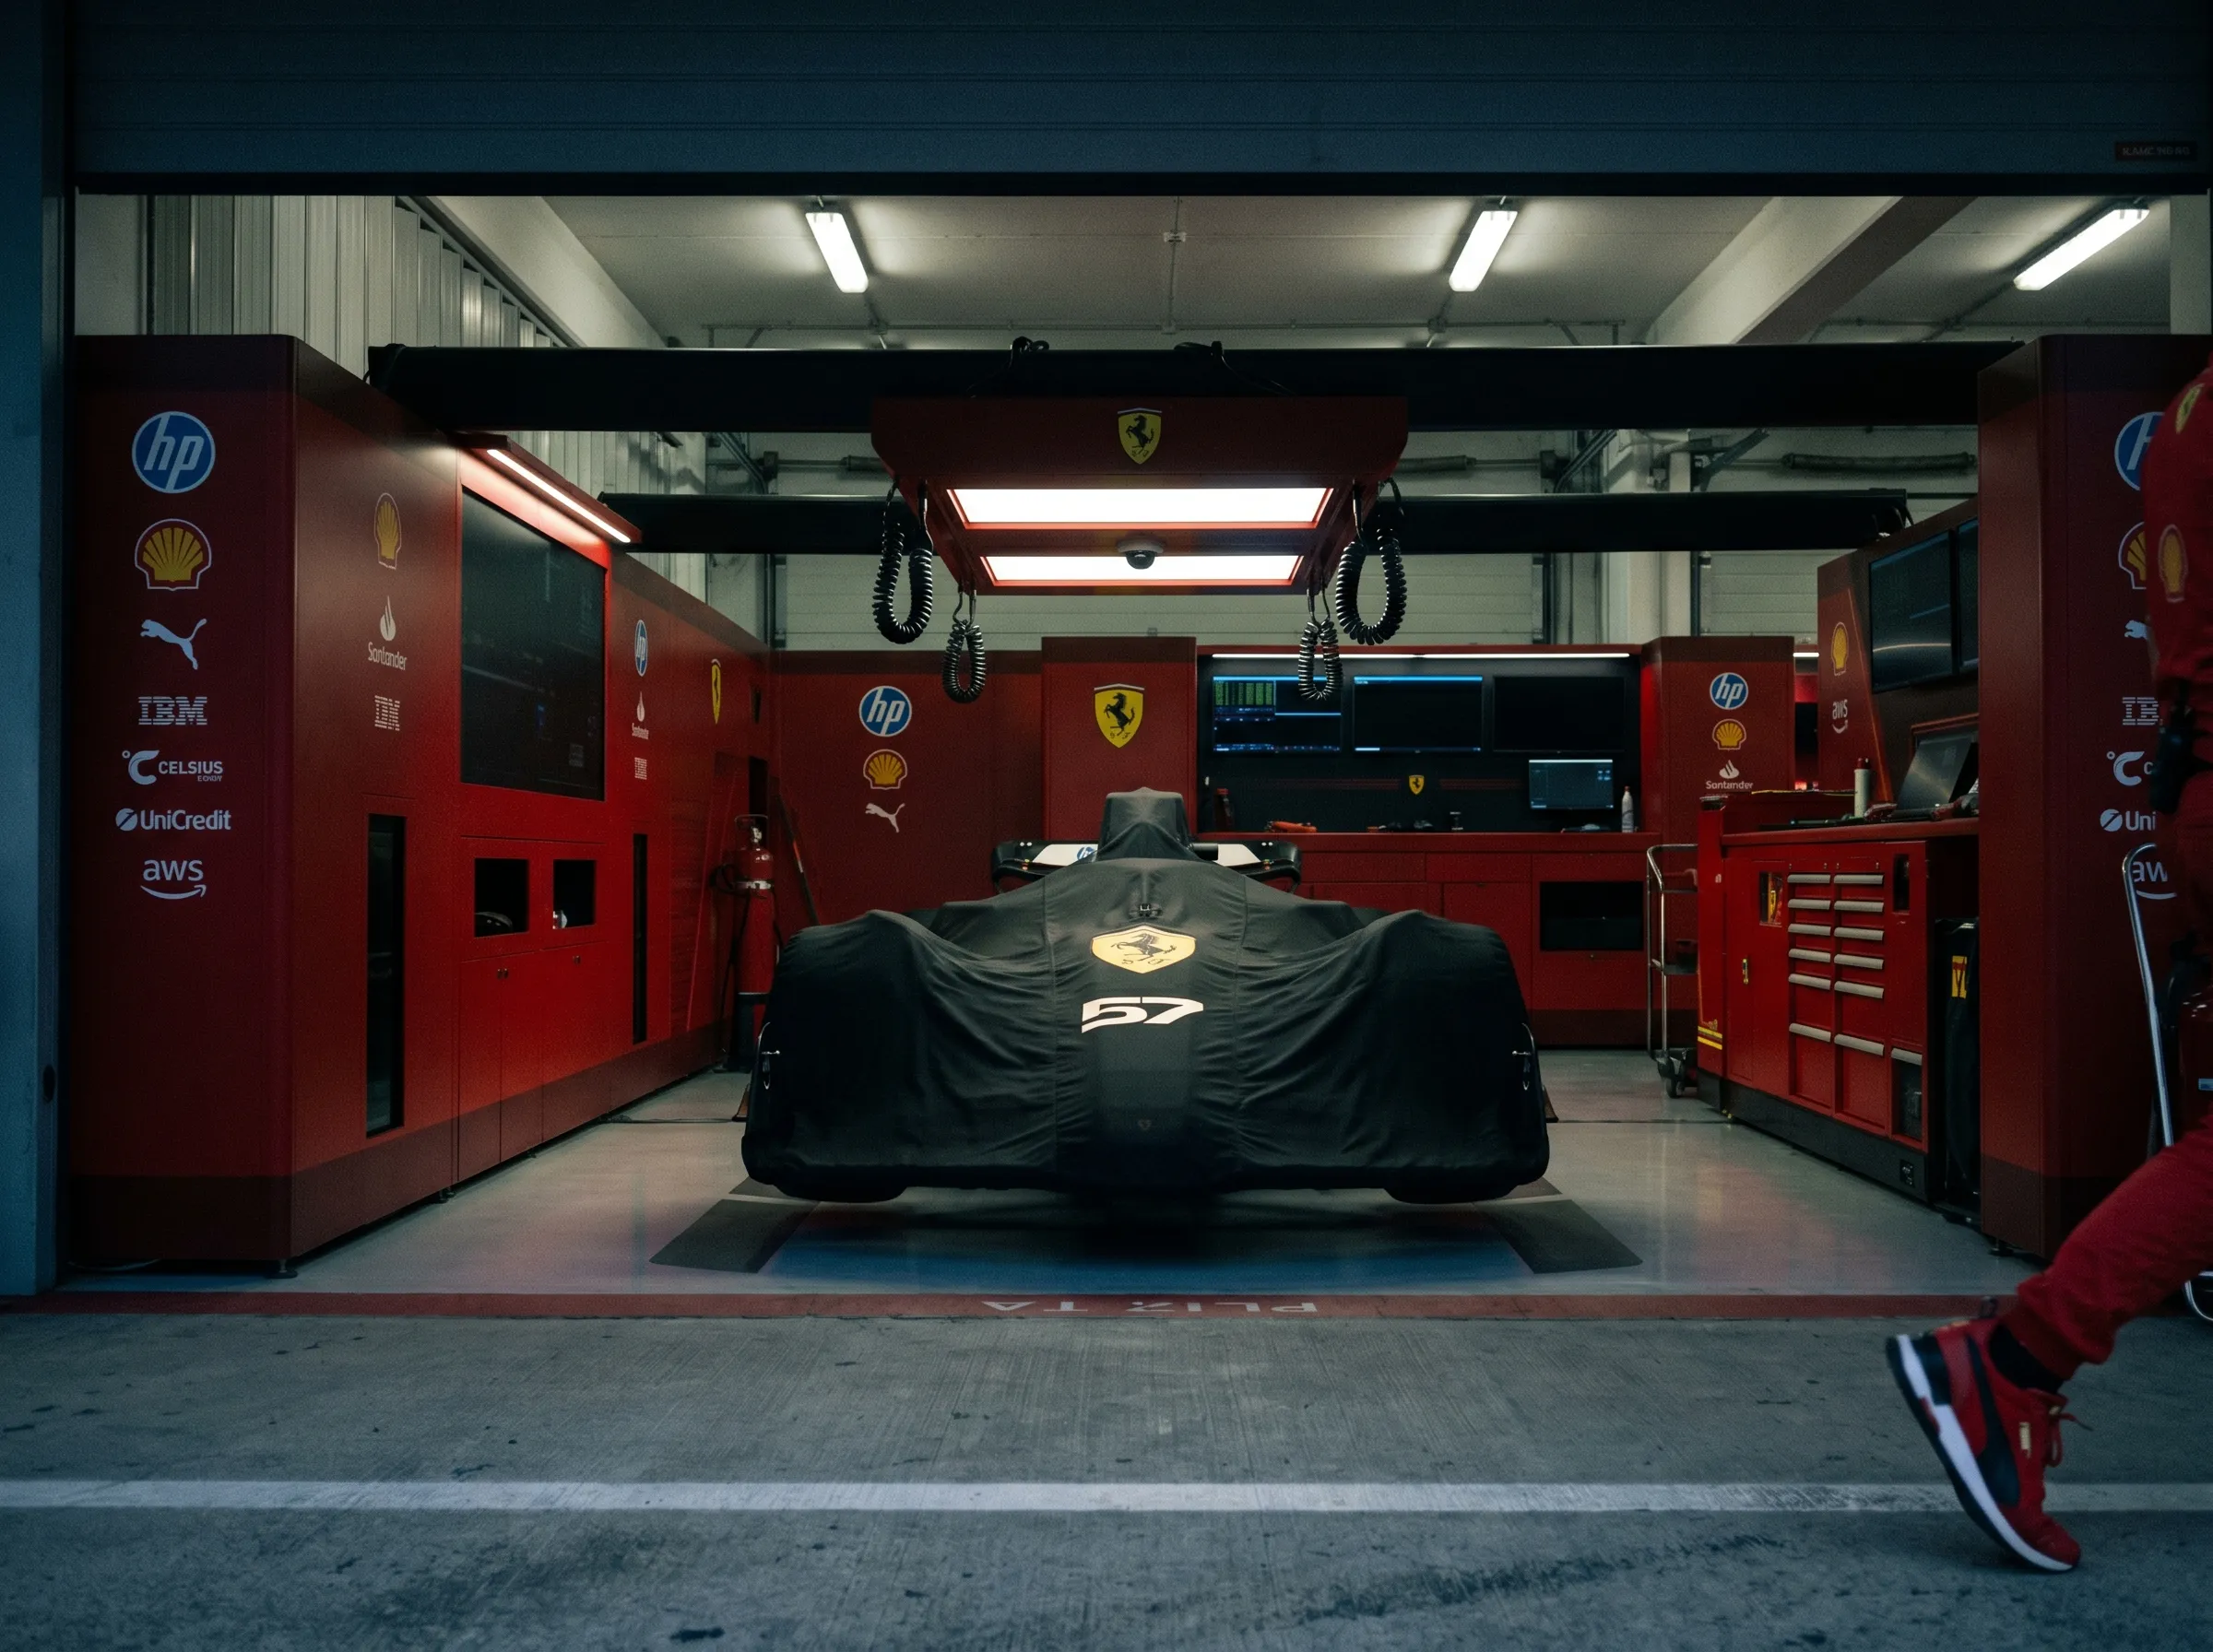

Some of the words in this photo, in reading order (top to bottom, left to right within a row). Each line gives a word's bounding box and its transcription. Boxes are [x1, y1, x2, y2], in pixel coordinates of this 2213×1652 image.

[143, 412, 204, 492] hp
[367, 641, 408, 671] Santander
[1716, 673, 1743, 709] hp
[138, 696, 207, 726] IBM
[866, 687, 905, 736] hp
[2122, 696, 2160, 726] IB
[159, 761, 224, 775] CELSIUS
[1705, 780, 1754, 790] Santander
[140, 809, 231, 831] UniCredit
[143, 859, 204, 882] aws
[2131, 862, 2168, 882] aw
[1081, 996, 1204, 1033] 57
